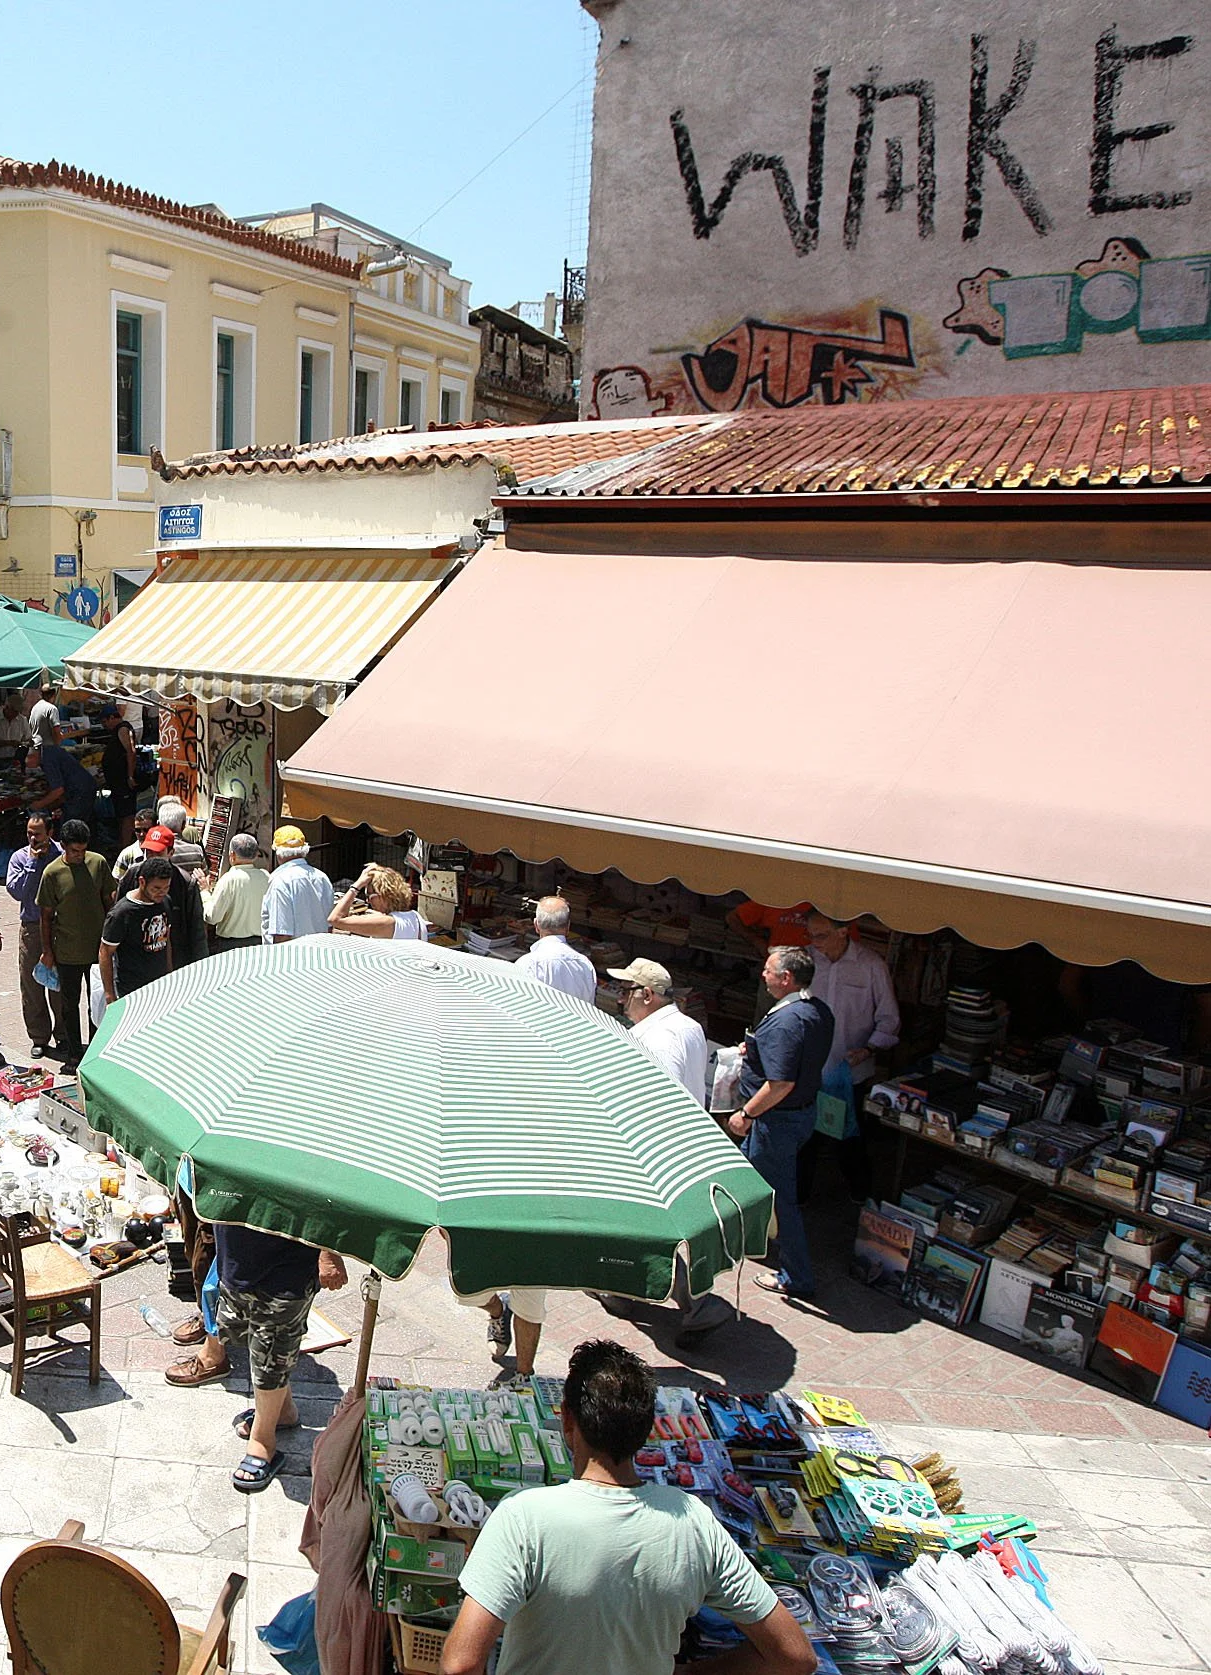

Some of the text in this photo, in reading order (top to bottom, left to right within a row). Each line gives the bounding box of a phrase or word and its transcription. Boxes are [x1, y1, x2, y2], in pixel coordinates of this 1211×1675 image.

[169, 508, 192, 517] ΟΔΟΣ
[163, 526, 196, 535] ASTINGOS
[1044, 1290, 1096, 1314] MONDADORI
